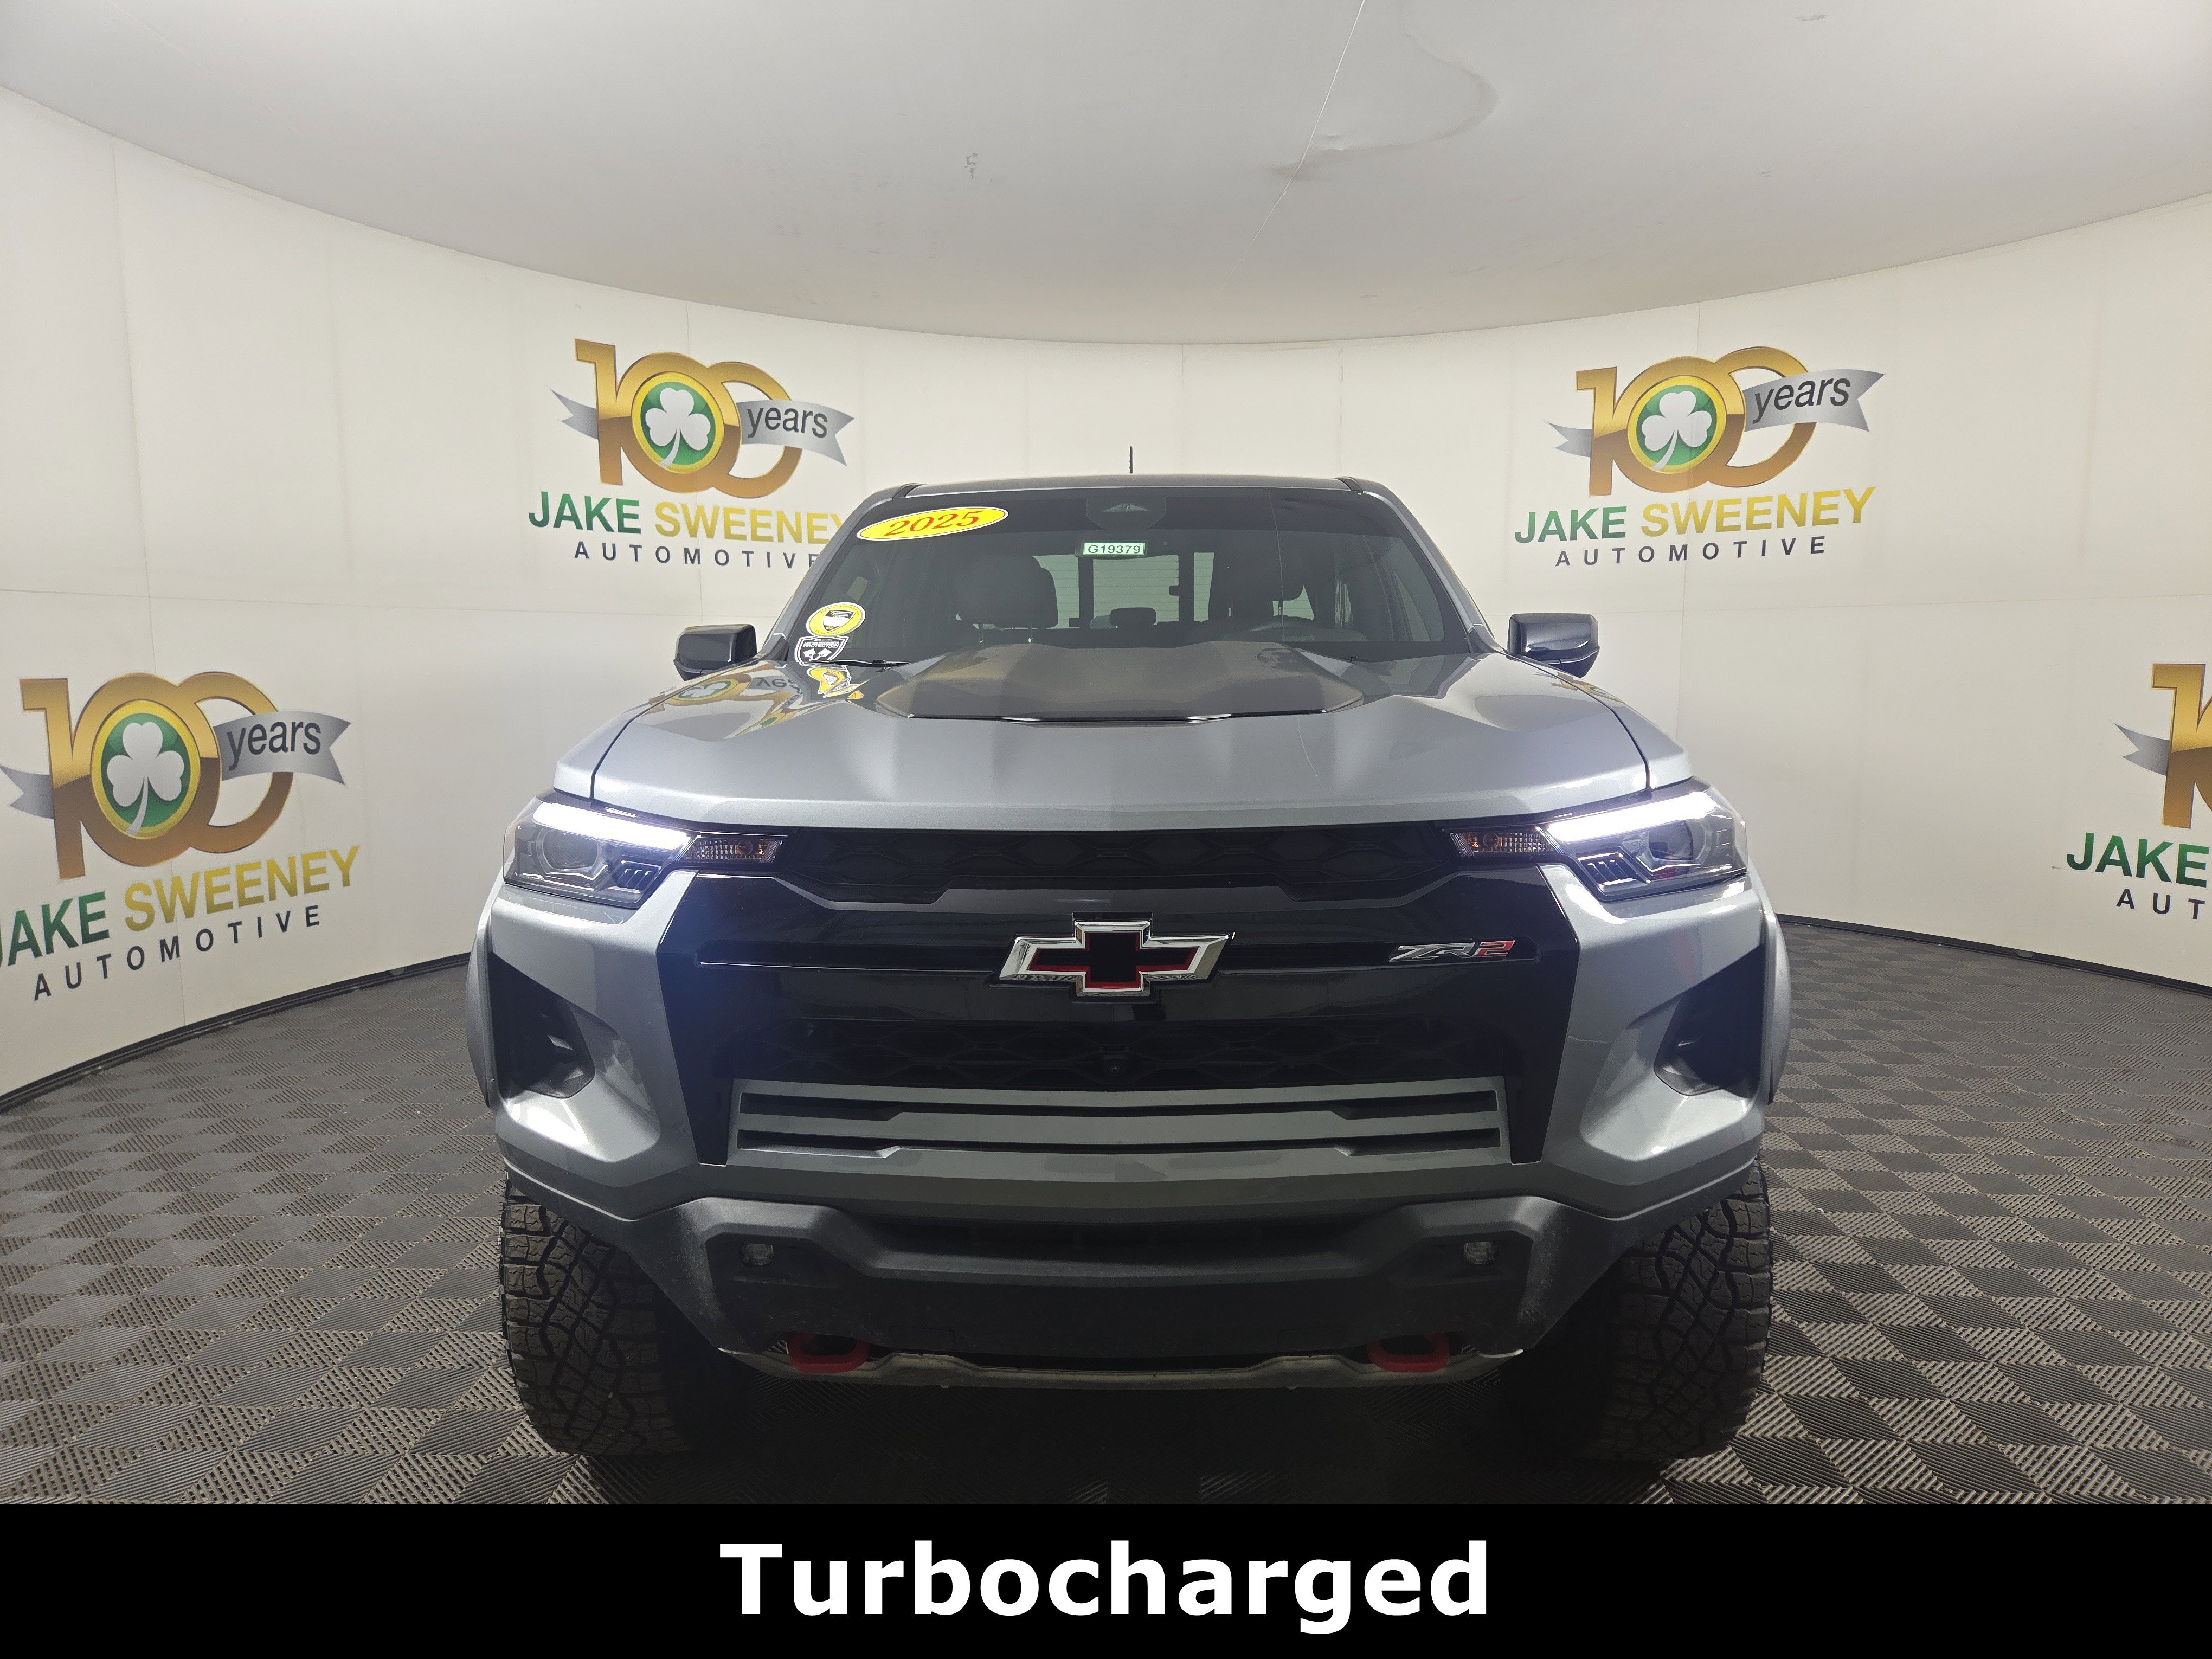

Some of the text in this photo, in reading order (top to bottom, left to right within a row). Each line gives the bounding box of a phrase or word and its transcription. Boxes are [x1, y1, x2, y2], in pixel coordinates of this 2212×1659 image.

[575, 338, 828, 498] 100 years
[1576, 346, 1850, 496] 100 years
[529, 491, 641, 534] JAKE
[883, 510, 984, 537] 2025
[1515, 486, 1876, 544] JAKE SWEENEY
[1088, 545, 1141, 554] G19379
[1555, 536, 1825, 567] AUTOMOTIVE
[19, 672, 322, 880] 100 years
[2066, 832, 2210, 888] JAKE
[0, 845, 359, 967] AKE SWEENEY
[2116, 888, 2205, 920] AUT
[34, 905, 320, 1001] AUTOMOTIVE
[1389, 940, 1516, 962] ZR2
